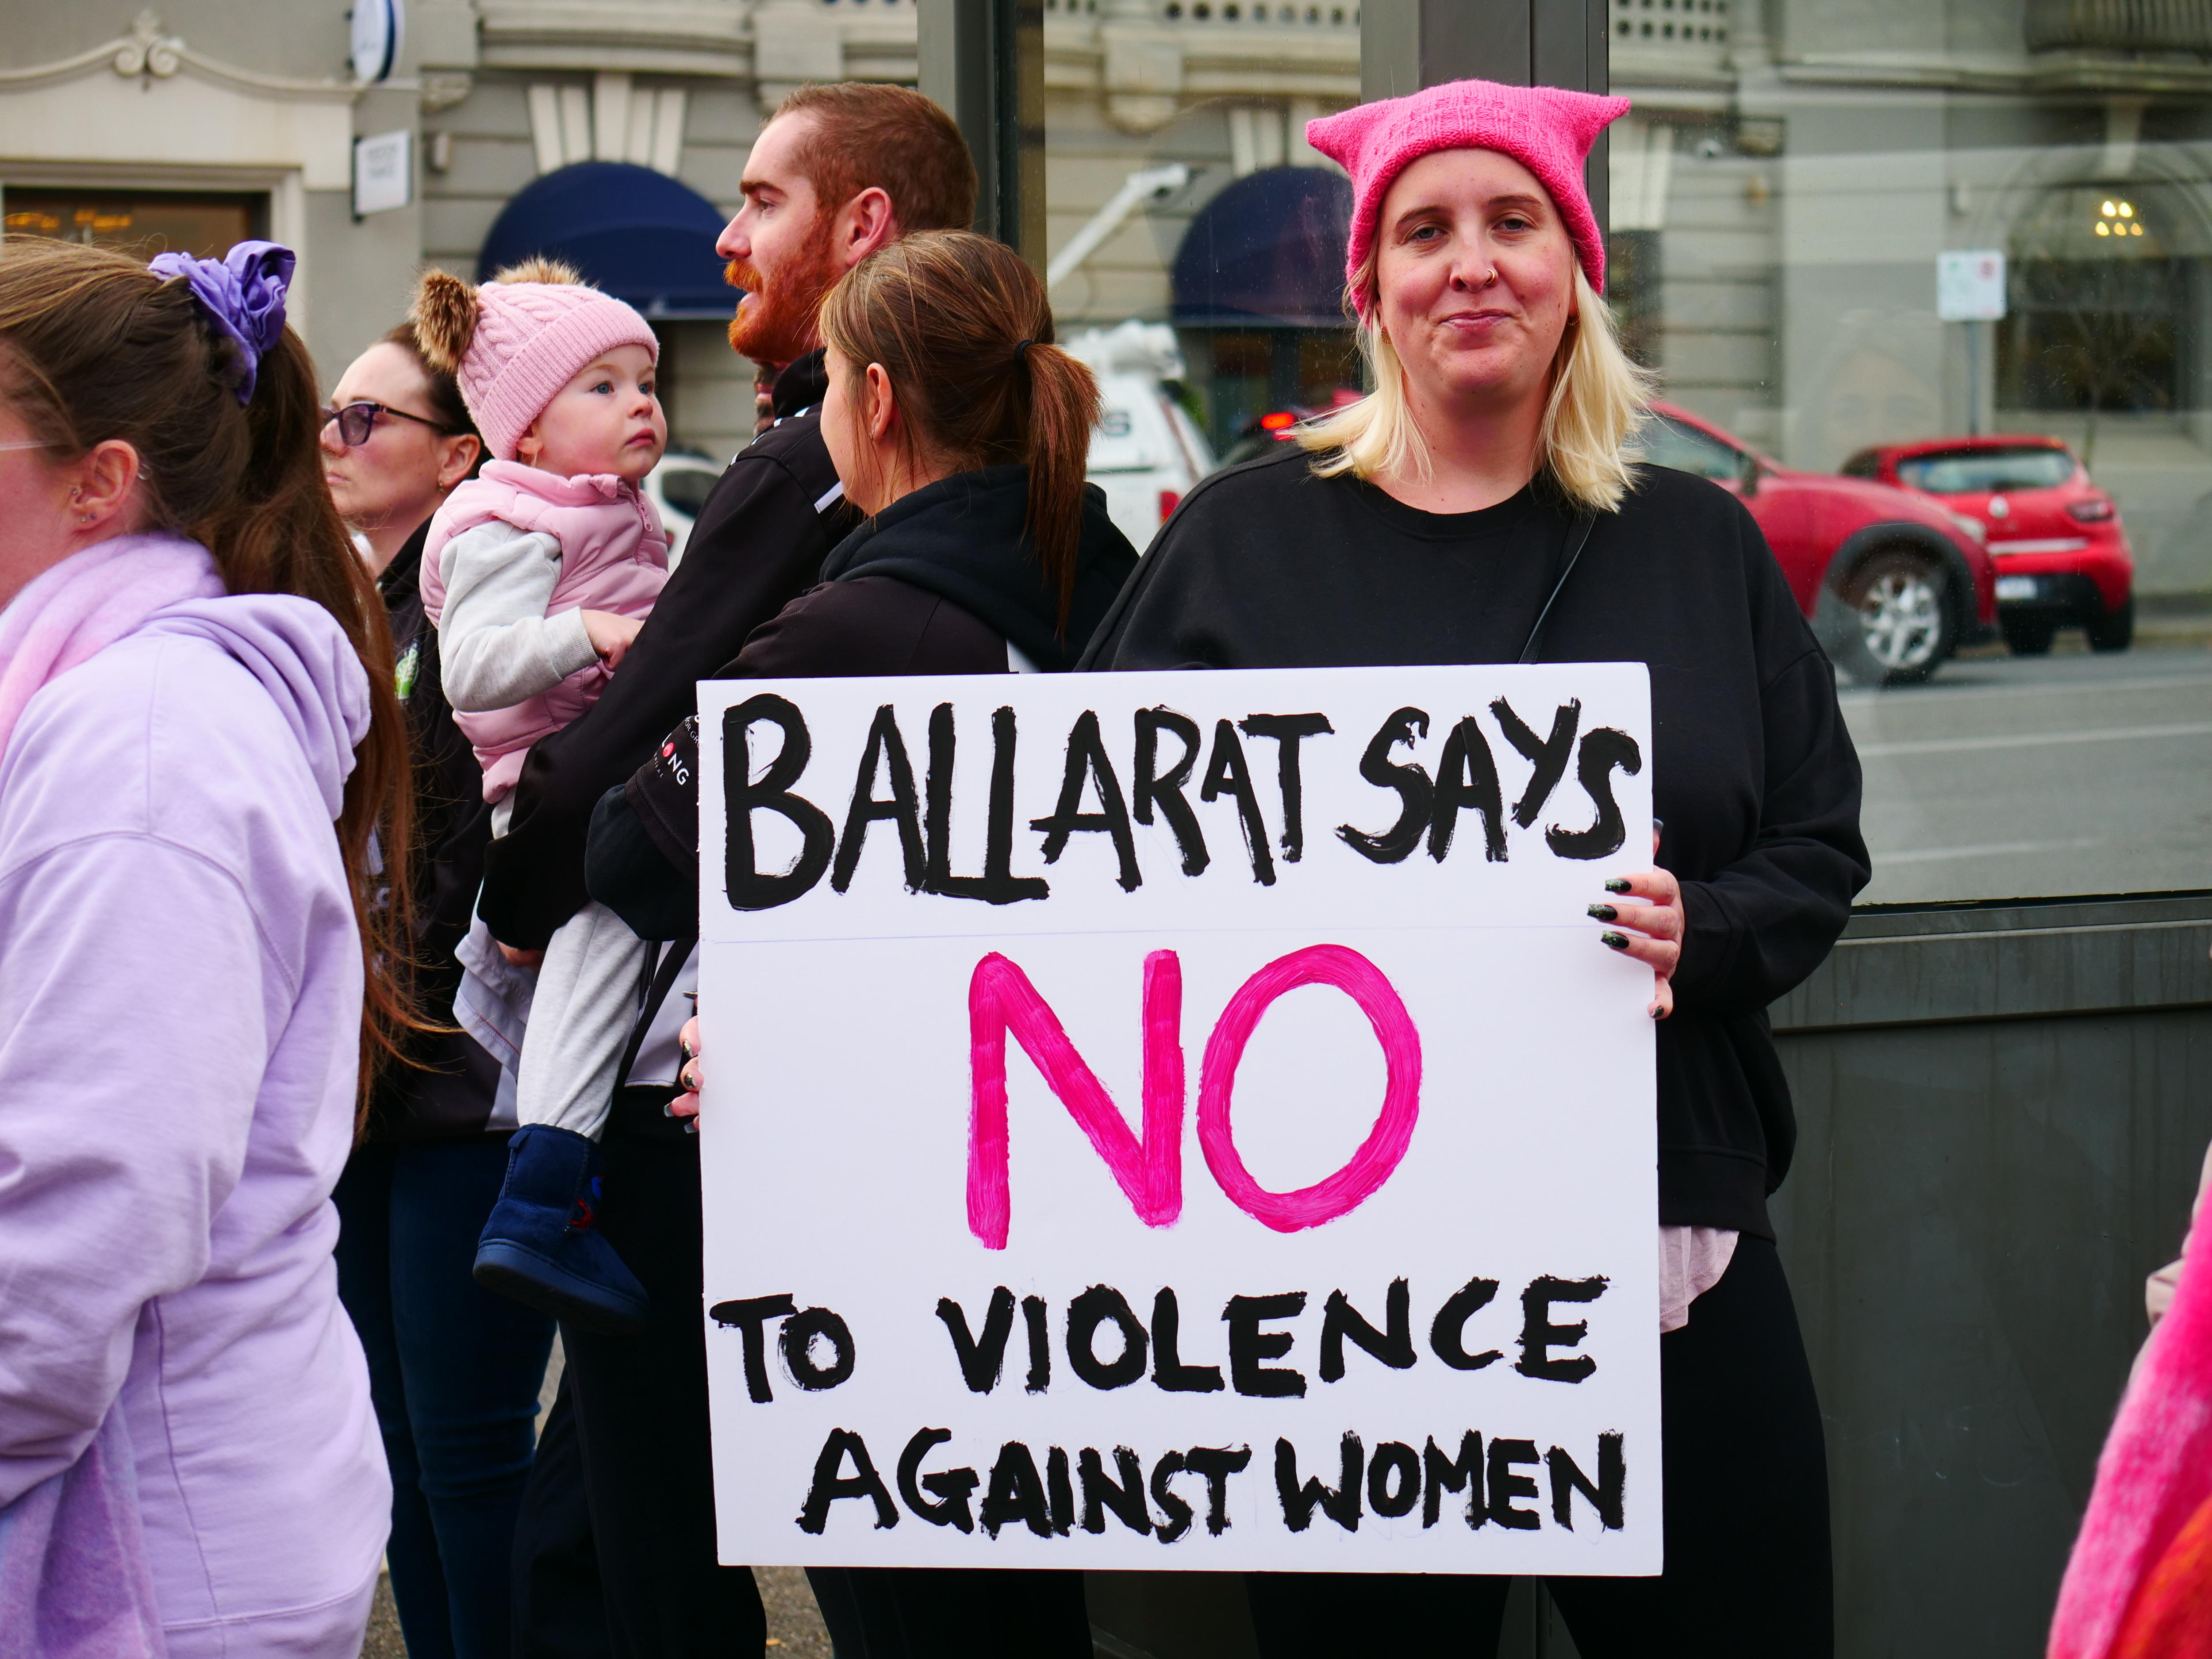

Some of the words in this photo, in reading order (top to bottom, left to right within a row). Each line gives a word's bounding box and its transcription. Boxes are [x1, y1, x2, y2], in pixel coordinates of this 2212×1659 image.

[722, 694, 1335, 911] BALLARAT
[1336, 695, 1642, 864] SAYS
[967, 944, 1422, 1250] NO
[710, 1293, 856, 1403] TO
[936, 1274, 1610, 1398] VIOLENCE
[795, 1427, 1252, 1544] AGAINST
[1275, 1429, 1626, 1533] WOMEN
